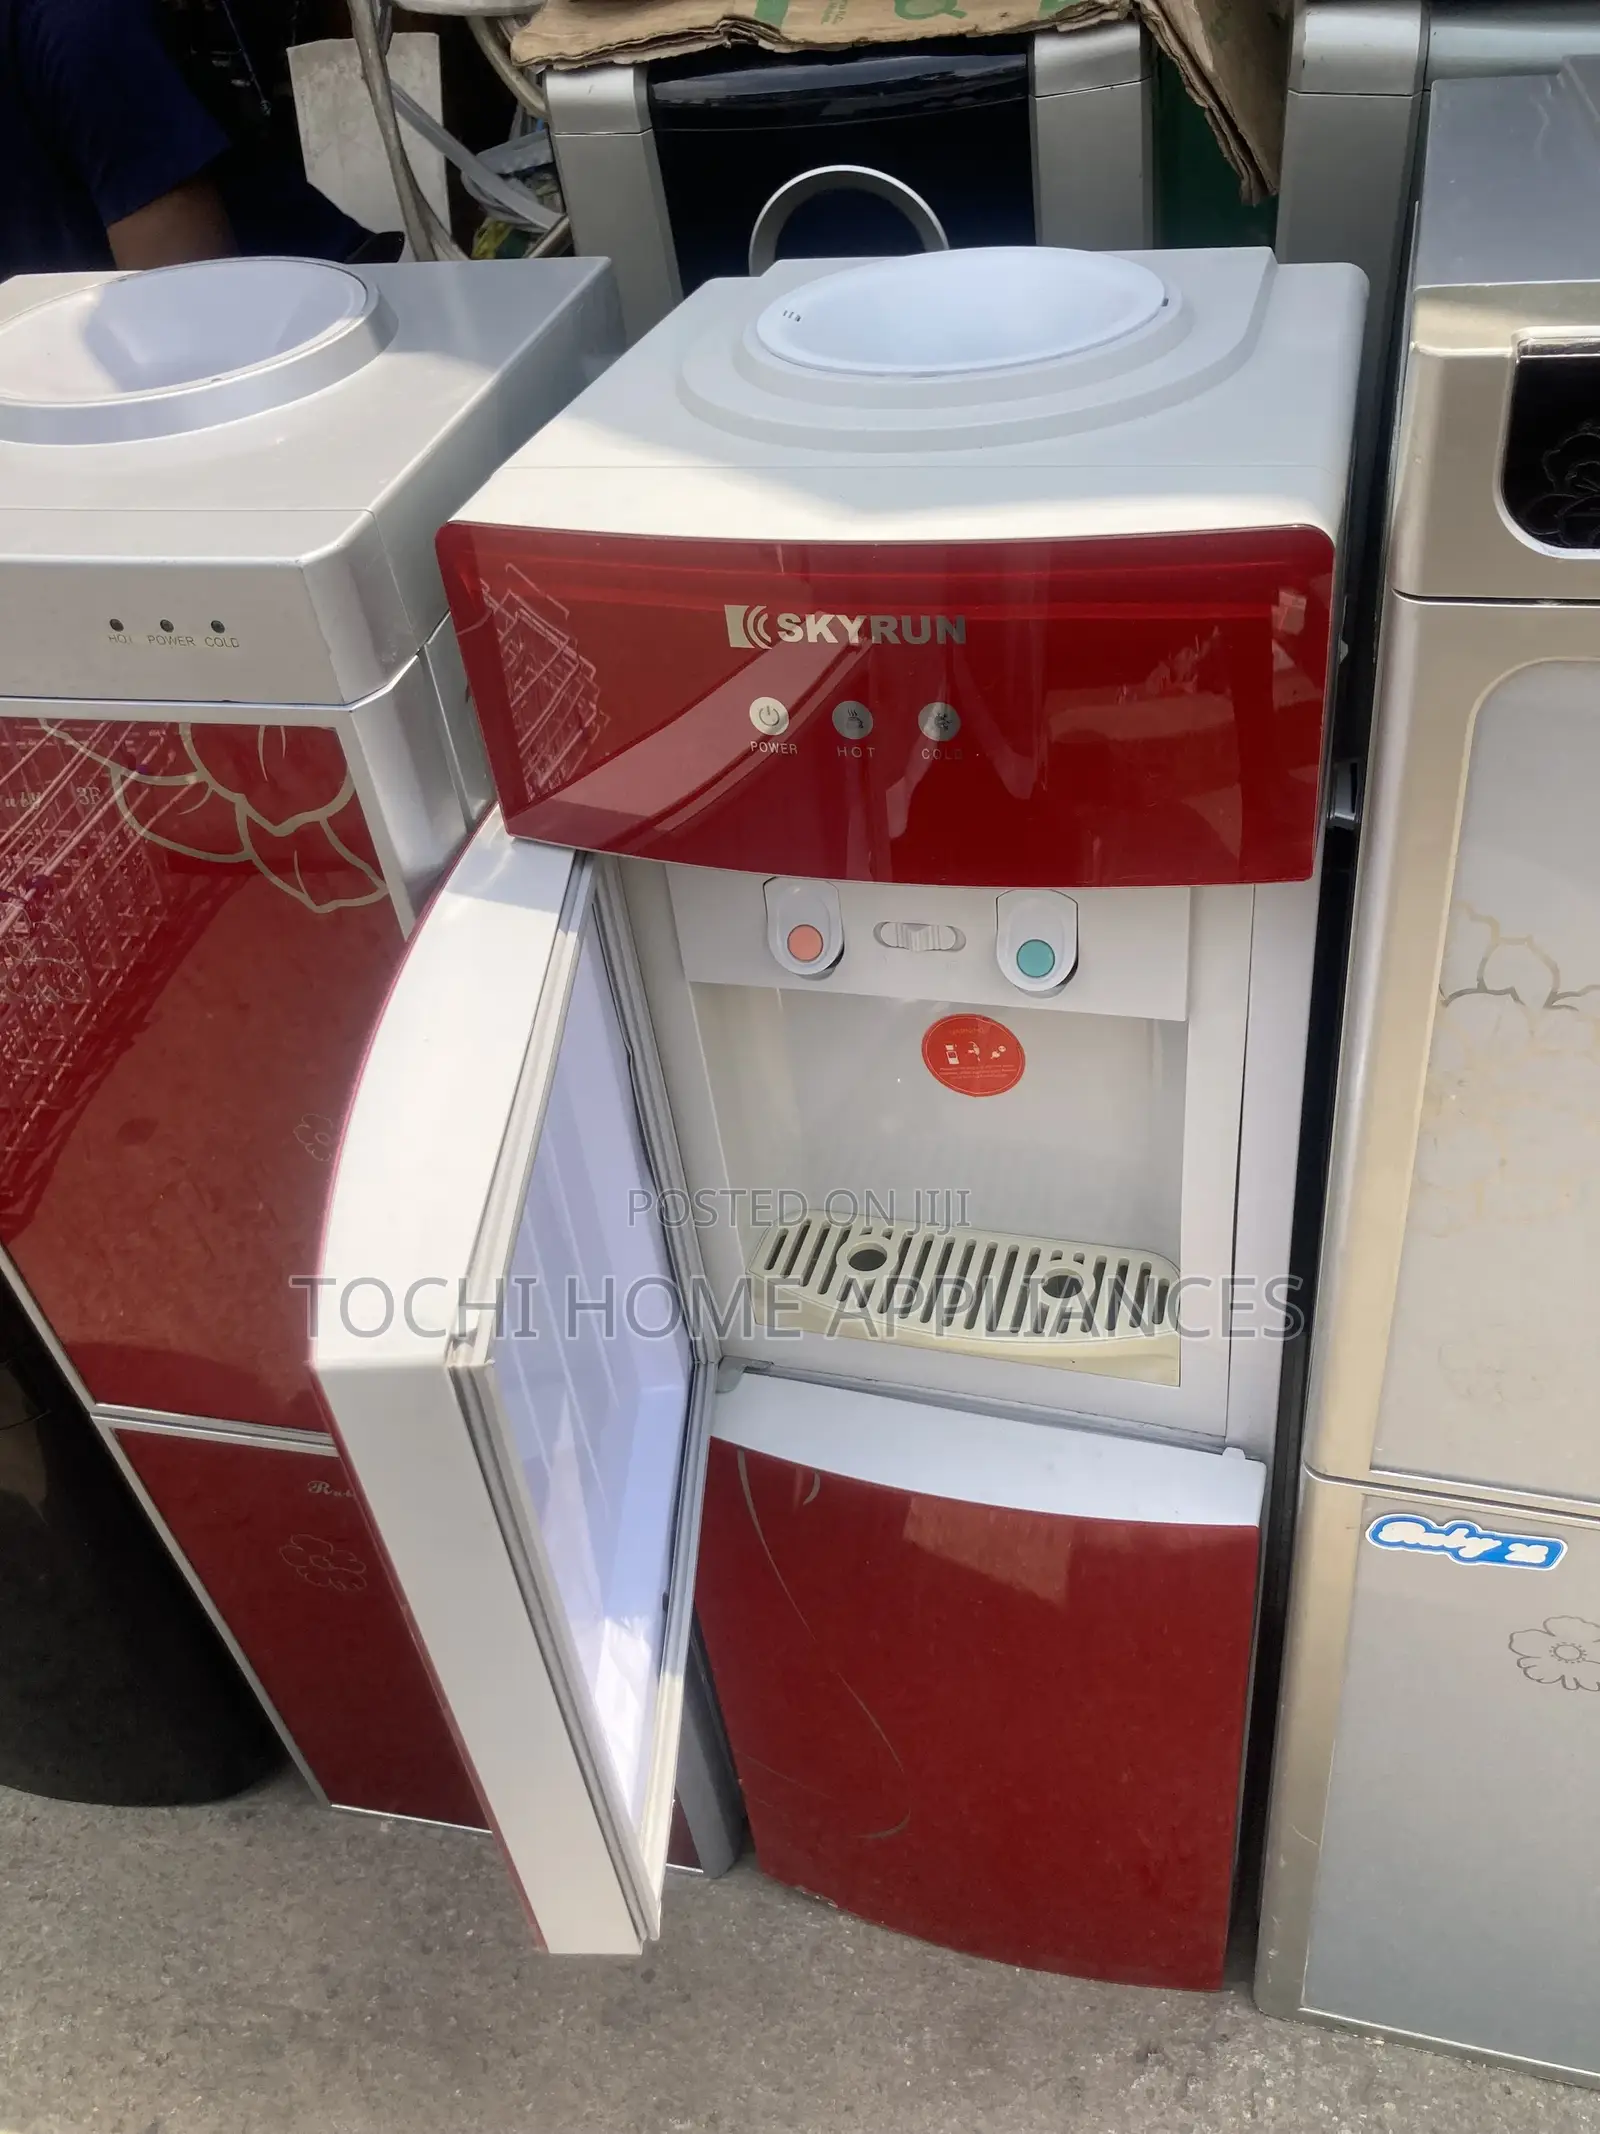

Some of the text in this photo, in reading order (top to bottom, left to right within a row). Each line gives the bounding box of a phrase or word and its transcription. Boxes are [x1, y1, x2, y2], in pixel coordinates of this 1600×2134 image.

[776, 612, 967, 645] SKYRUN
[146, 634, 197, 647] POWER
[204, 636, 240, 648] COLD
[749, 740, 964, 760] POWER HOT COLD
